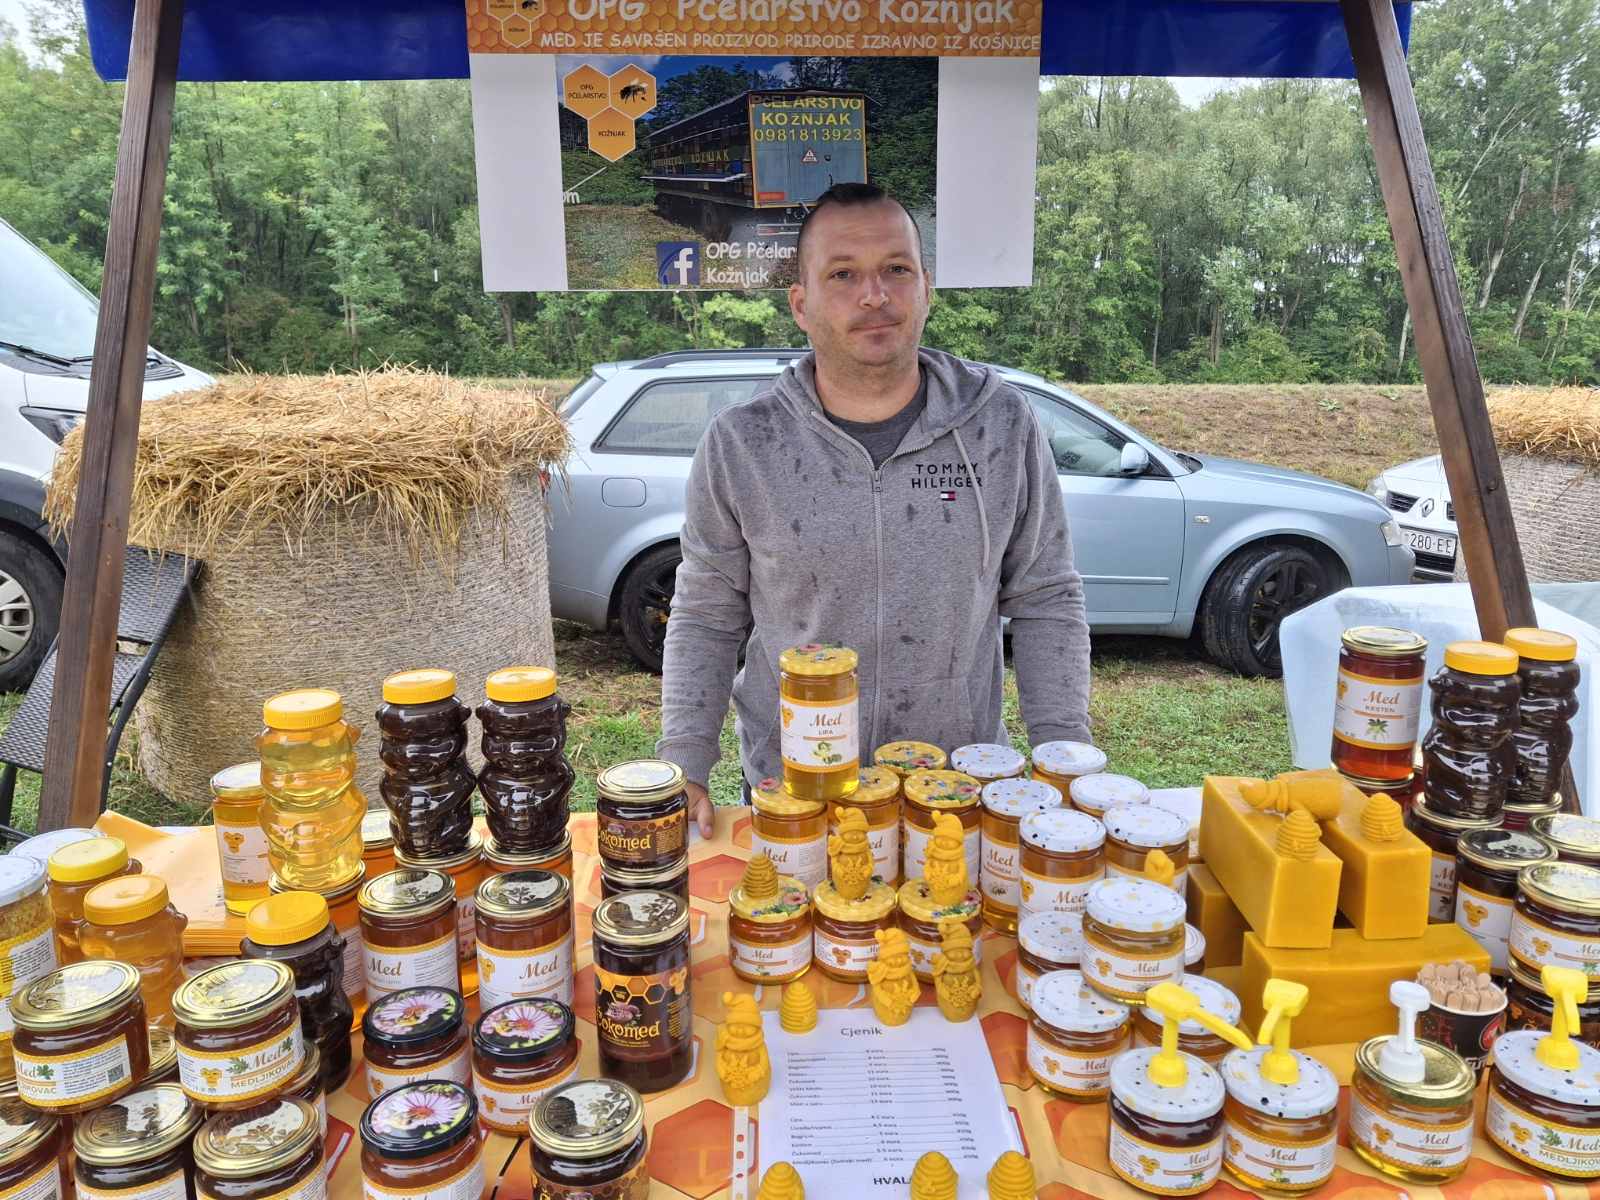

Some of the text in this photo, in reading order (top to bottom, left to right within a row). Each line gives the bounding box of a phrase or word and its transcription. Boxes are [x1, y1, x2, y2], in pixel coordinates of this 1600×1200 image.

[567, 0, 644, 21] OPG
[541, 29, 1040, 50] MED JE SAVRŠEN PROIZVOD PRIRODE IZRAVNO IZ KOŠNICE
[754, 128, 862, 142] 0981813923
[705, 241, 798, 260] OPG Pčelar
[706, 266, 769, 288] Kožnjak
[915, 462, 978, 475] TOMMY
[911, 477, 983, 489] HILFIGER
[1362, 690, 1401, 705] Med
[809, 713, 843, 727] Med
[986, 848, 1014, 866] Med
[752, 949, 774, 960] Med
[367, 957, 402, 976] Med
[519, 955, 558, 980] Med
[1132, 962, 1160, 974] Med
[840, 1027, 883, 1037] Cjenik
[249, 1047, 282, 1070] Med
[1079, 1060, 1107, 1072] Med
[1418, 1133, 1450, 1145] Med
[1561, 1136, 1600, 1151] Med
[1183, 1152, 1210, 1166] Med
[1264, 1148, 1298, 1162] Med
